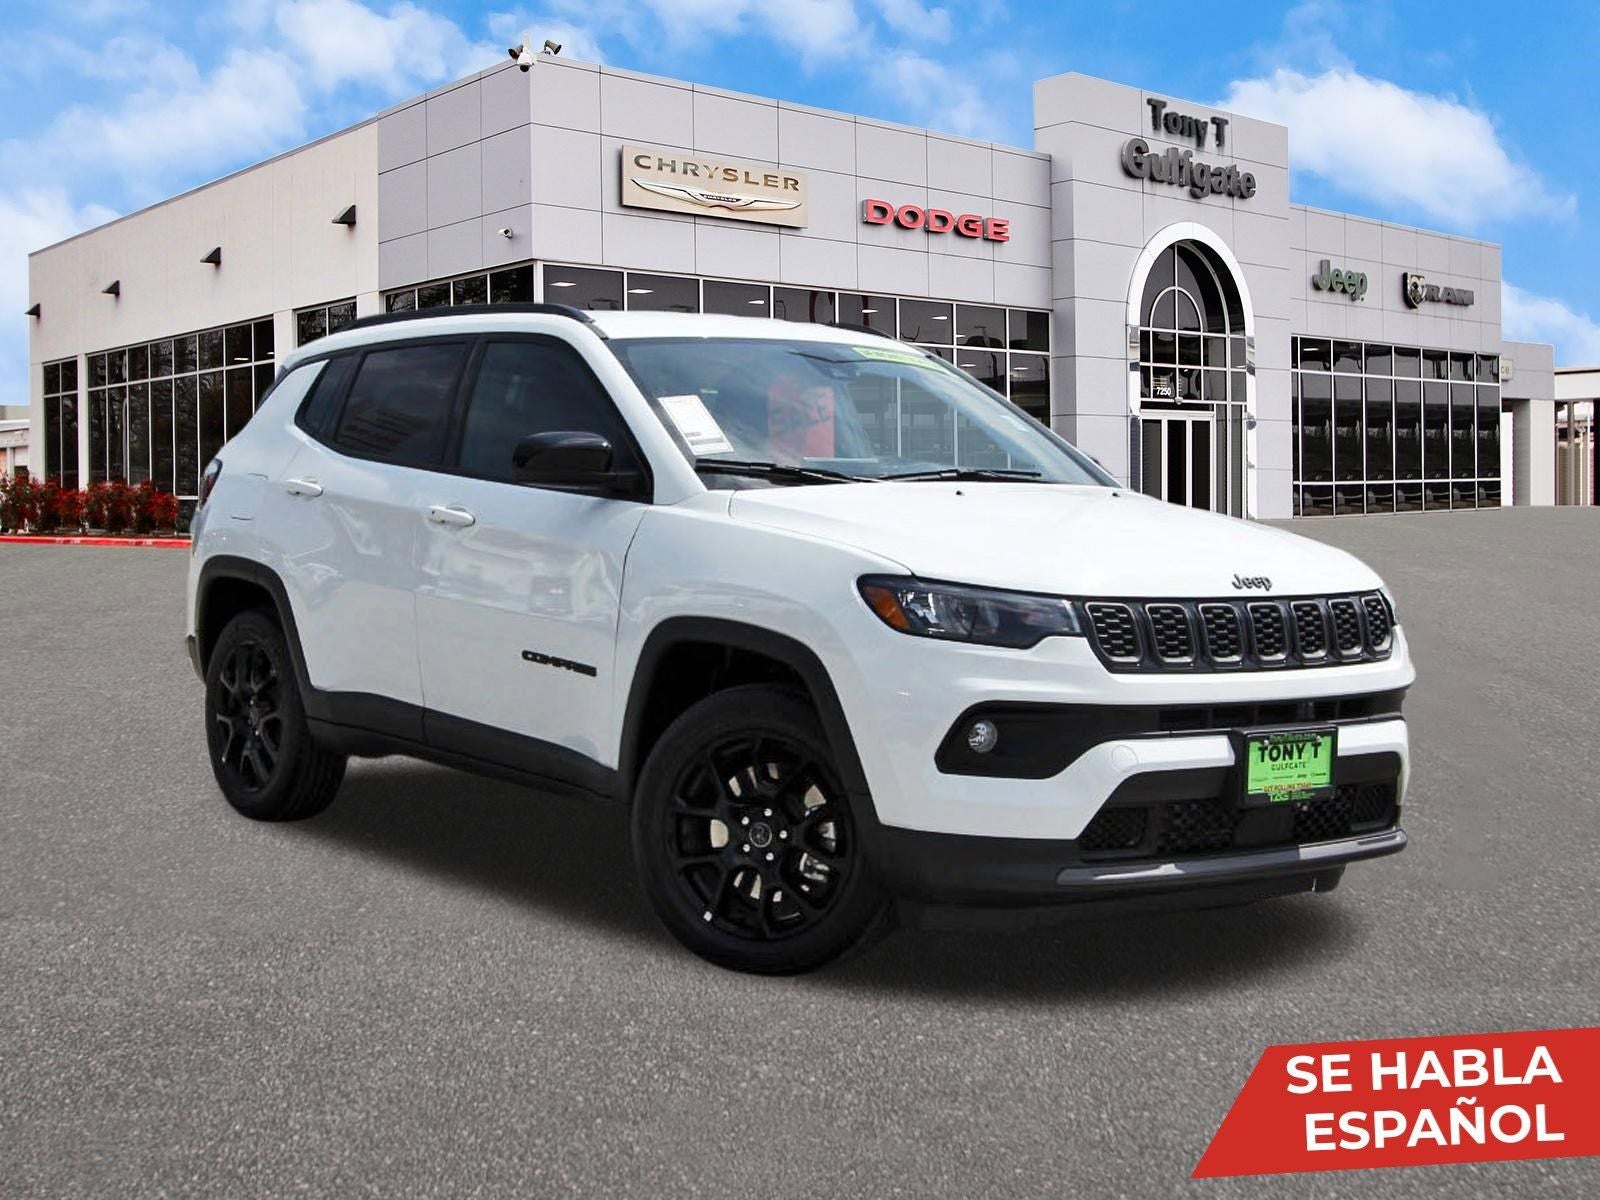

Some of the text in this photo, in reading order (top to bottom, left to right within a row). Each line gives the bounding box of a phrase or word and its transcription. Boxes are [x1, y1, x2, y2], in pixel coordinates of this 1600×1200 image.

[1146, 97, 1230, 148] Tony T
[633, 153, 801, 192] CHRYSLER
[1121, 137, 1257, 199] Gulfgate
[861, 198, 1011, 243] DODGE
[1312, 258, 1369, 302] Jeep
[1424, 283, 1475, 306] RAM
[1155, 386, 1172, 396] 7250
[1231, 573, 1273, 592] Jeep
[1257, 740, 1322, 763] TONY T
